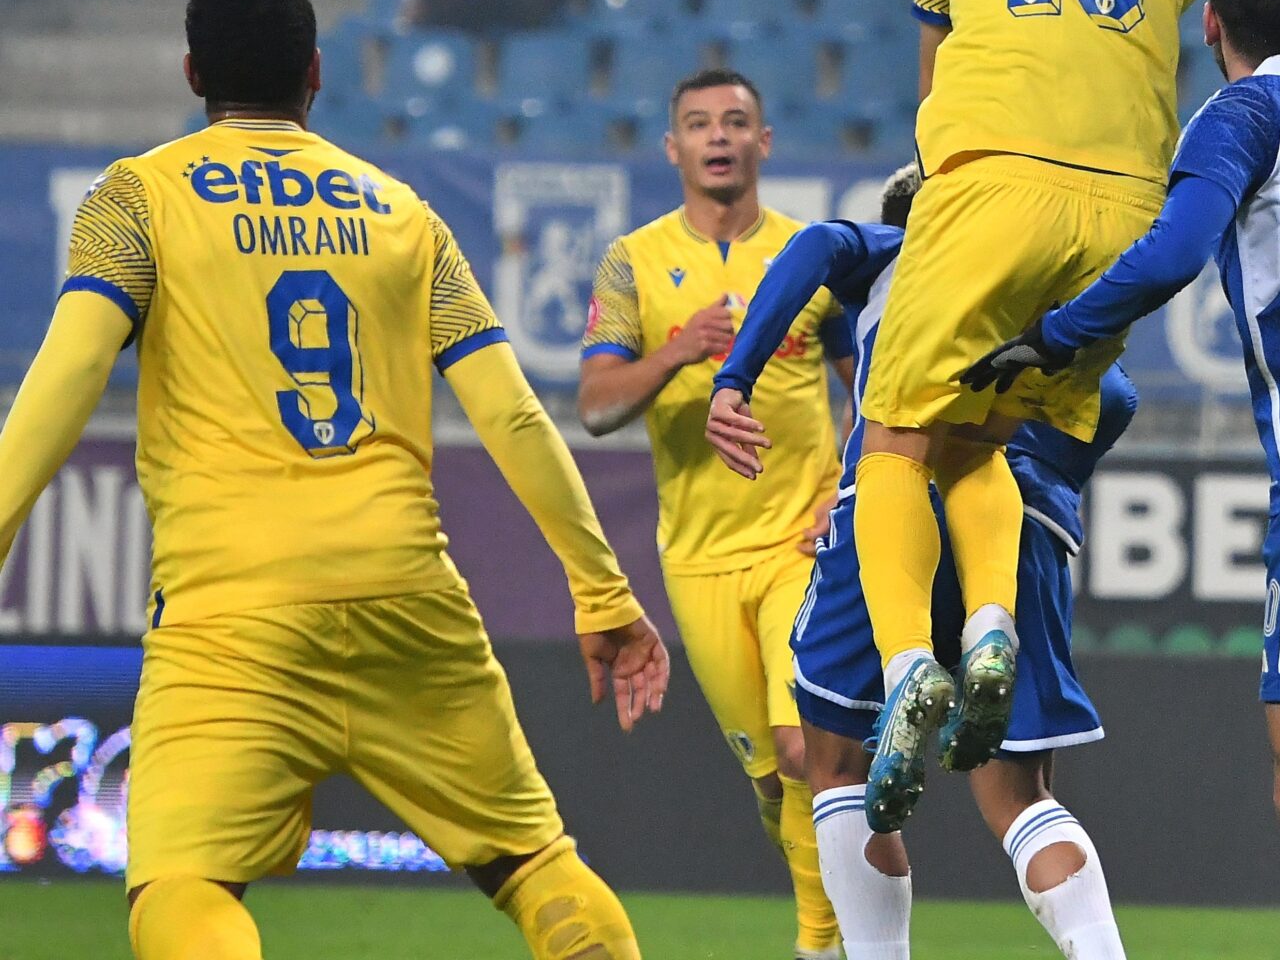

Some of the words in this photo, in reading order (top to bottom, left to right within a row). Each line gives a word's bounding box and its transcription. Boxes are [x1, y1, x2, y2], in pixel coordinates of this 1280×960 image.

[190, 159, 391, 214] efbet
[233, 213, 369, 256] OMRANI
[266, 270, 376, 459] 9
